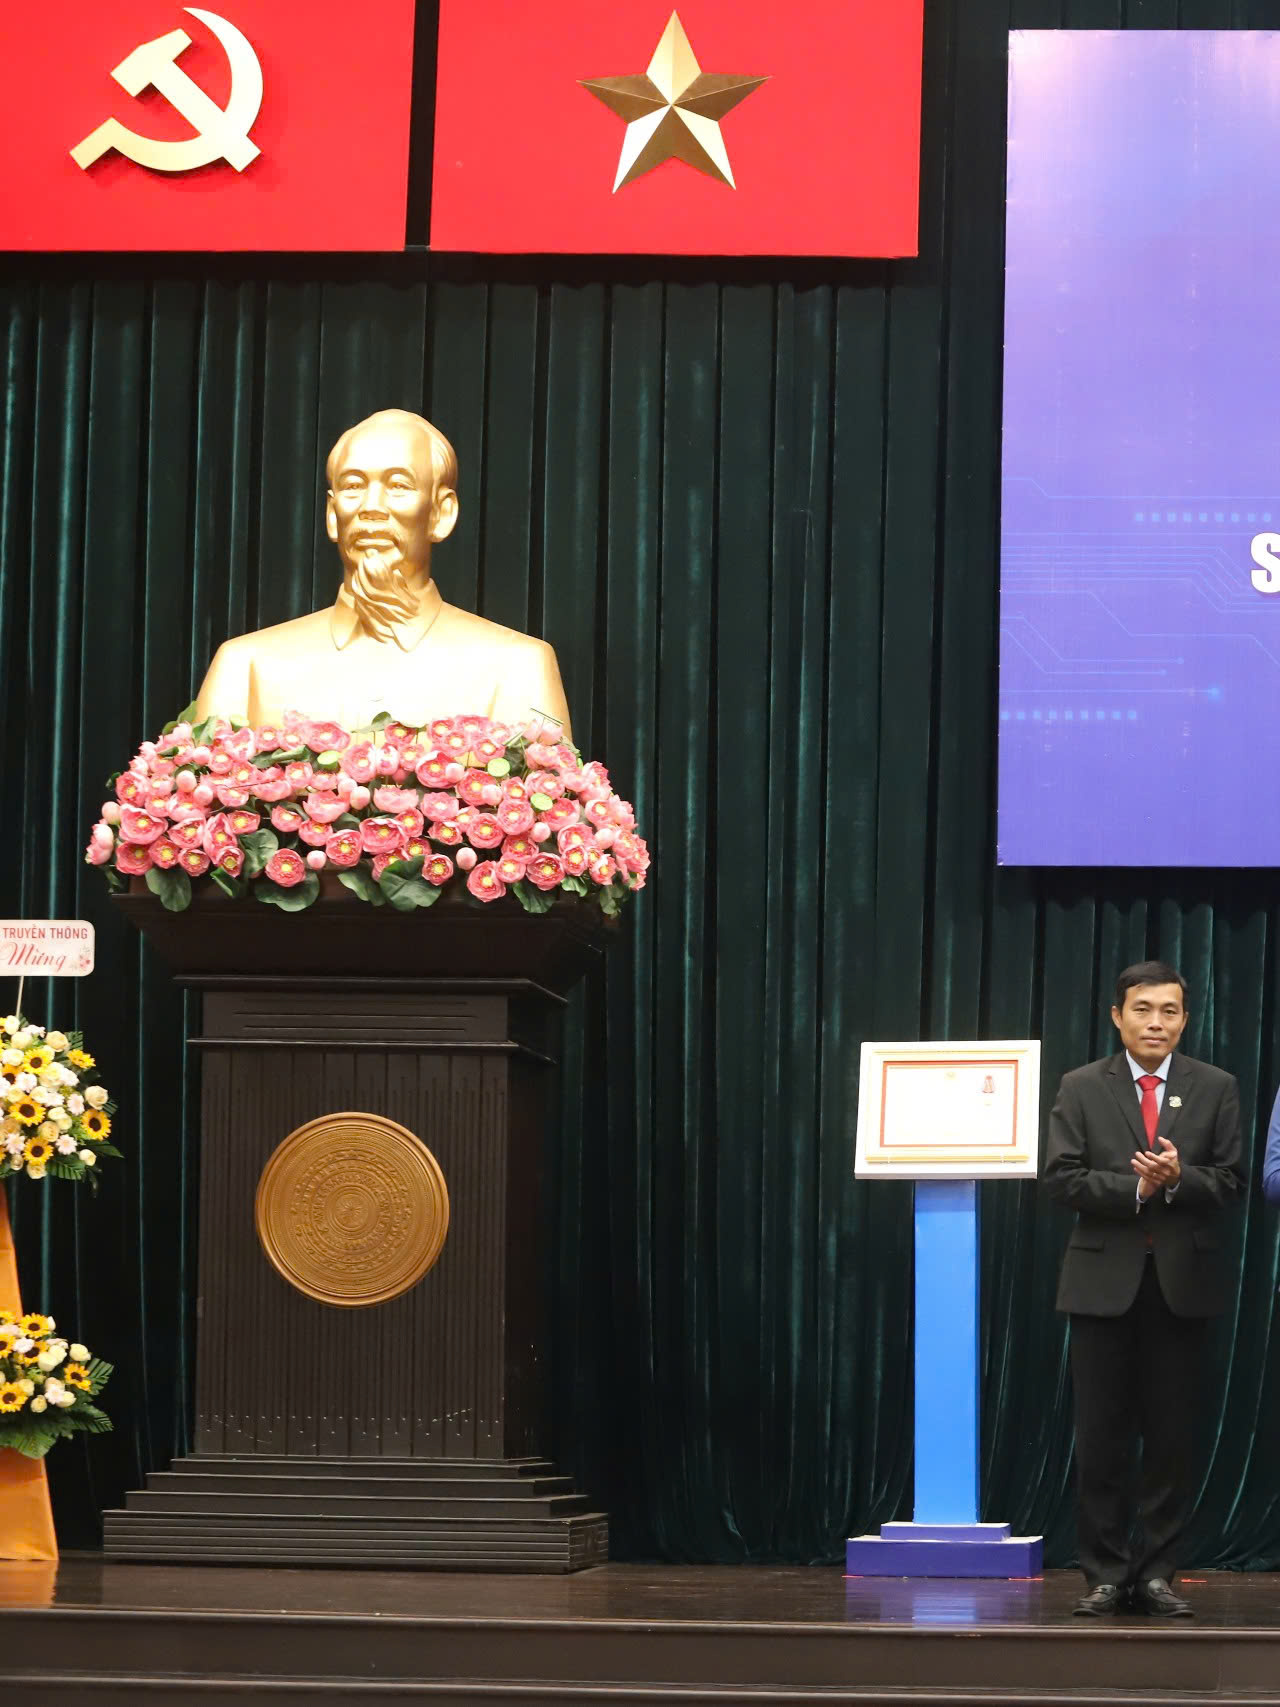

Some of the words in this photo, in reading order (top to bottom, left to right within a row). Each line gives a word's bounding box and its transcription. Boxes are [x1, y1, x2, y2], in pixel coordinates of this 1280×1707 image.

[3, 923, 46, 939] TRUYỀN
[50, 926, 88, 940] THÔNG
[7, 941, 67, 972] Mừng
